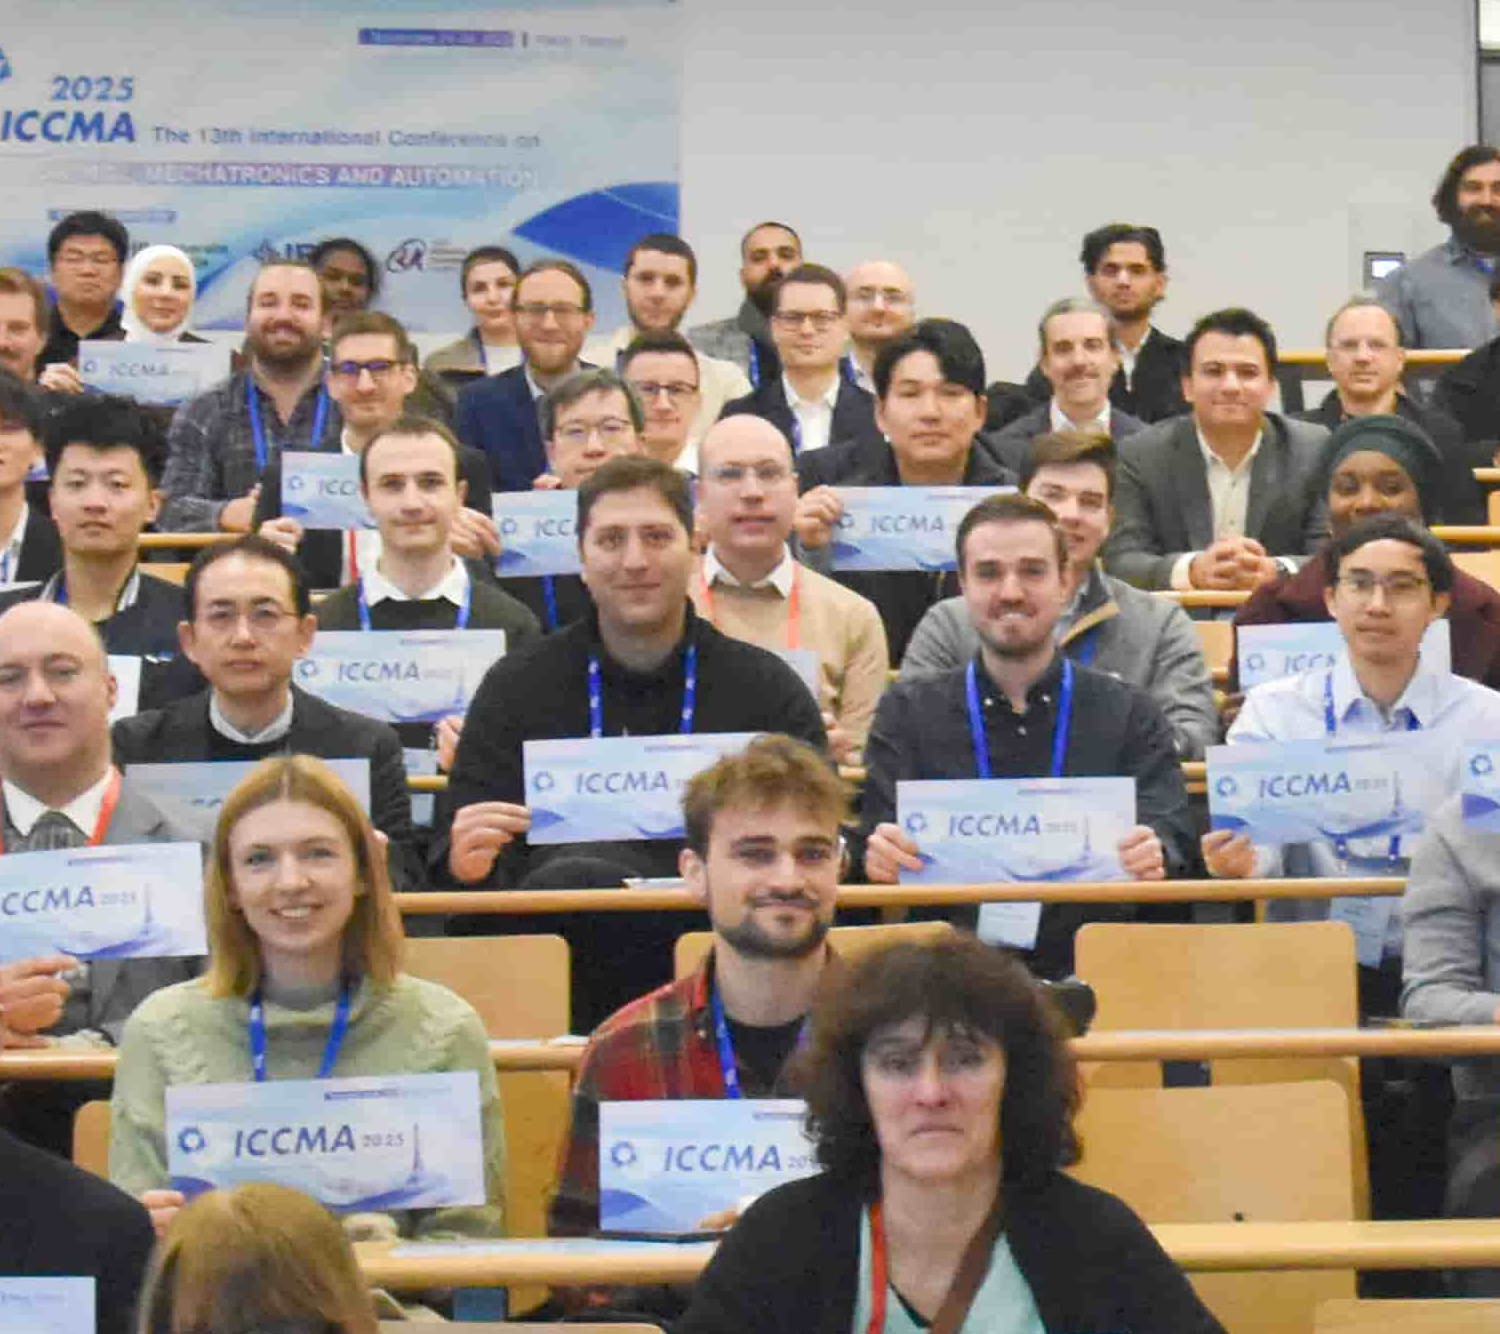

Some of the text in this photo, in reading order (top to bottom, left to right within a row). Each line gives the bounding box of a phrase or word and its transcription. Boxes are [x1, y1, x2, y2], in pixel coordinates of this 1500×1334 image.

[52, 75, 134, 101] 2025
[0, 110, 135, 143] ICCMA
[153, 126, 541, 149] The 13th International Conference on
[337, 167, 384, 185] AND
[317, 479, 357, 496] ICC
[535, 515, 577, 537] ICC
[871, 515, 945, 534] ICCMA
[337, 661, 421, 683] ICCMA
[575, 771, 670, 795] ICCMA
[1258, 772, 1352, 798] ICCMA
[948, 813, 1042, 837] ICCMA
[235, 1124, 356, 1158] ICCMA
[663, 1144, 782, 1172] ICCMA
